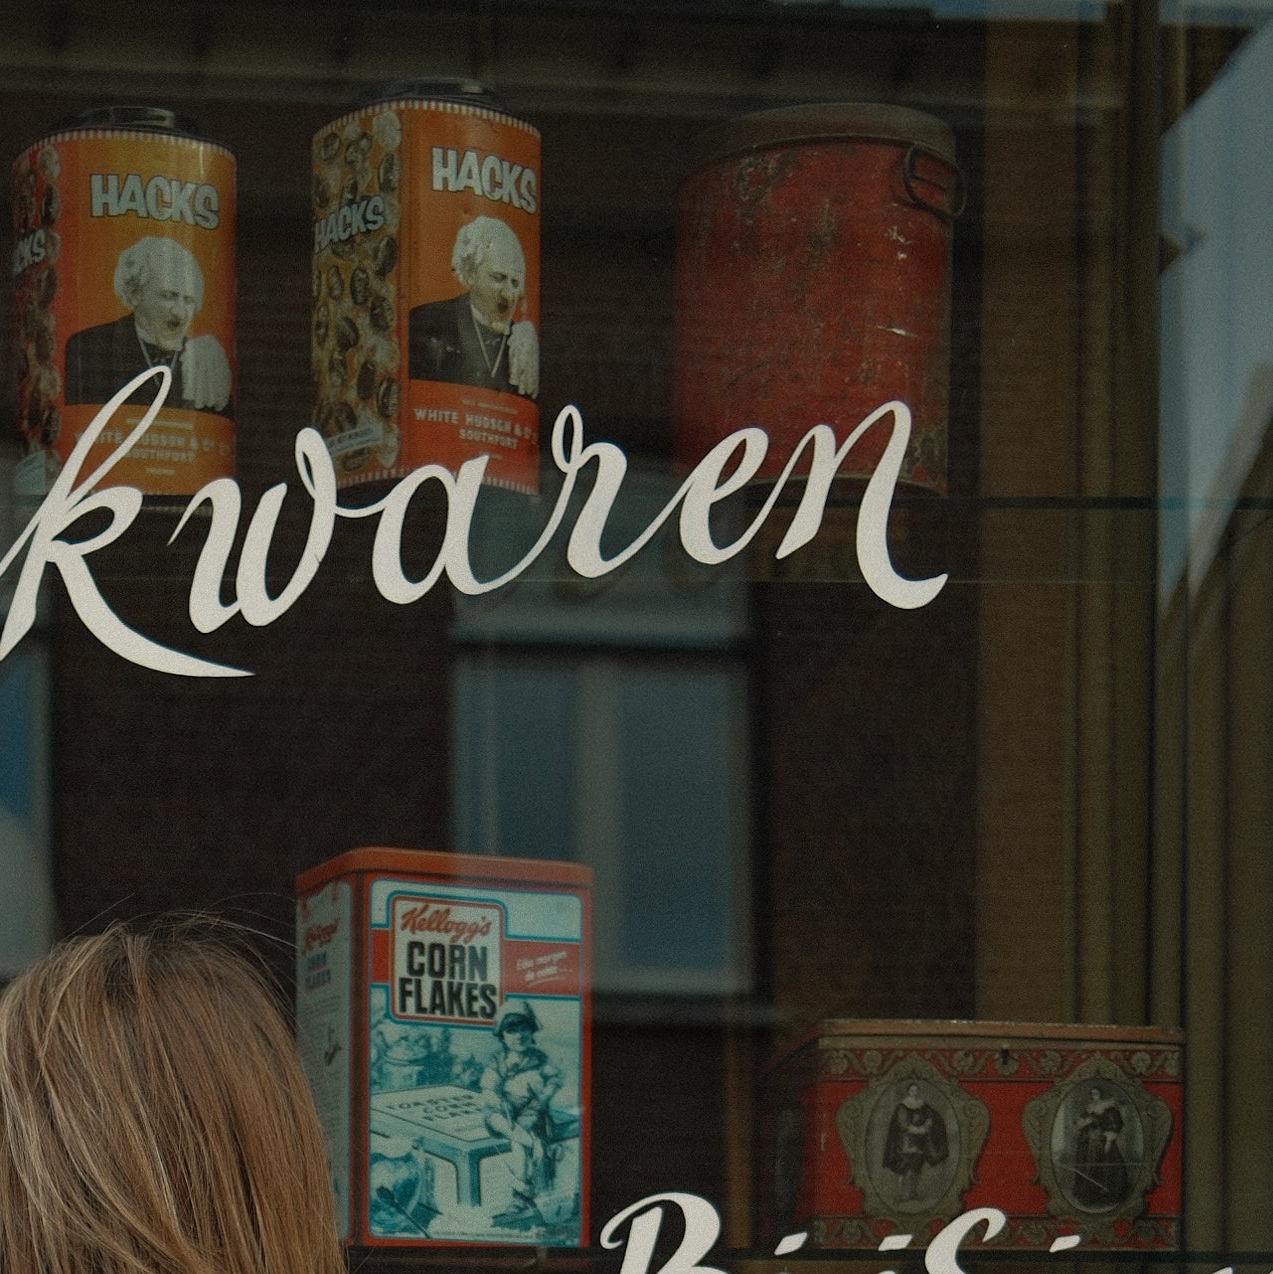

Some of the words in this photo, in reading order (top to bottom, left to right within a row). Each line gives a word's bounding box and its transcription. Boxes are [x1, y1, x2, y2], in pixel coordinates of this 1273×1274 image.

[431, 146, 539, 215] HACKS
[89, 173, 220, 230] HACKS
[313, 196, 386, 253] HACKS
[413, 408, 460, 424] WHITE
[401, 904, 493, 944] Kellogg's
[407, 941, 488, 981] CORN
[399, 978, 497, 1019] FLAKES
